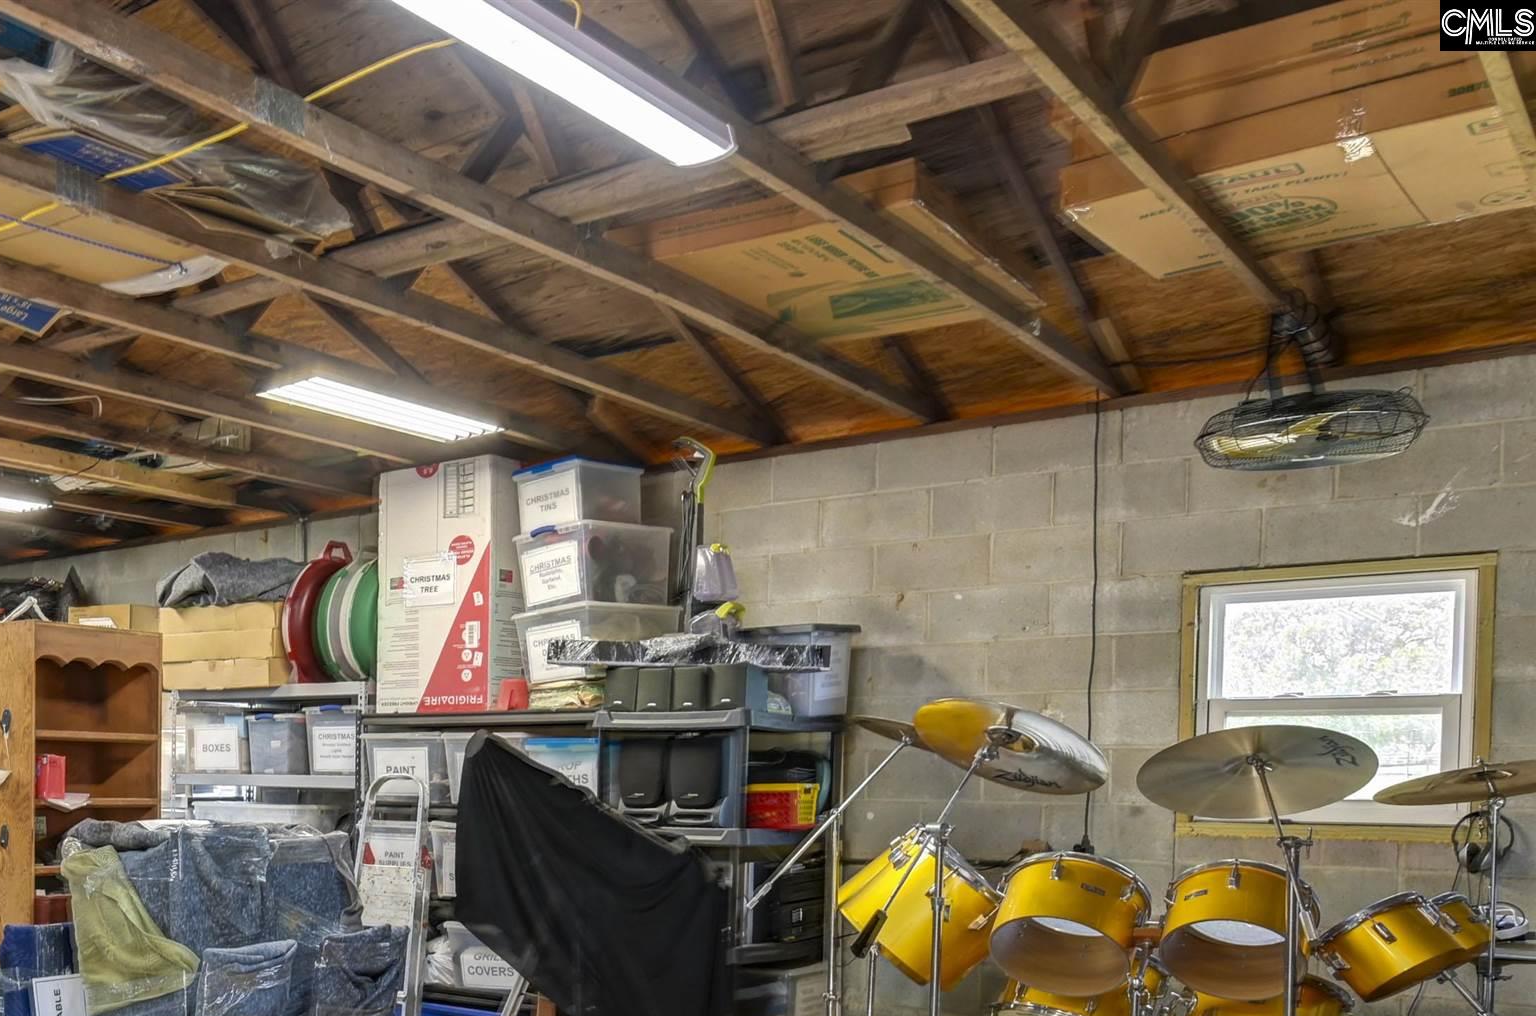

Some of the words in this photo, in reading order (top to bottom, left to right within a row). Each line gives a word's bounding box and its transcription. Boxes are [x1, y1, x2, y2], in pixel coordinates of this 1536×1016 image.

[0, 304, 29, 320] Large
[526, 488, 570, 506] CHRISTMAS
[539, 502, 558, 512] TINS
[529, 555, 572, 574] CHRISTMAS
[409, 573, 451, 584] CHRISTMAS
[424, 695, 483, 706] FRIGIDAIRE
[202, 743, 231, 752] BOXES
[386, 765, 416, 775] PAINT
[992, 767, 1062, 789] Zildjian
[384, 851, 405, 859] PAINT
[467, 966, 514, 977] COVERS
